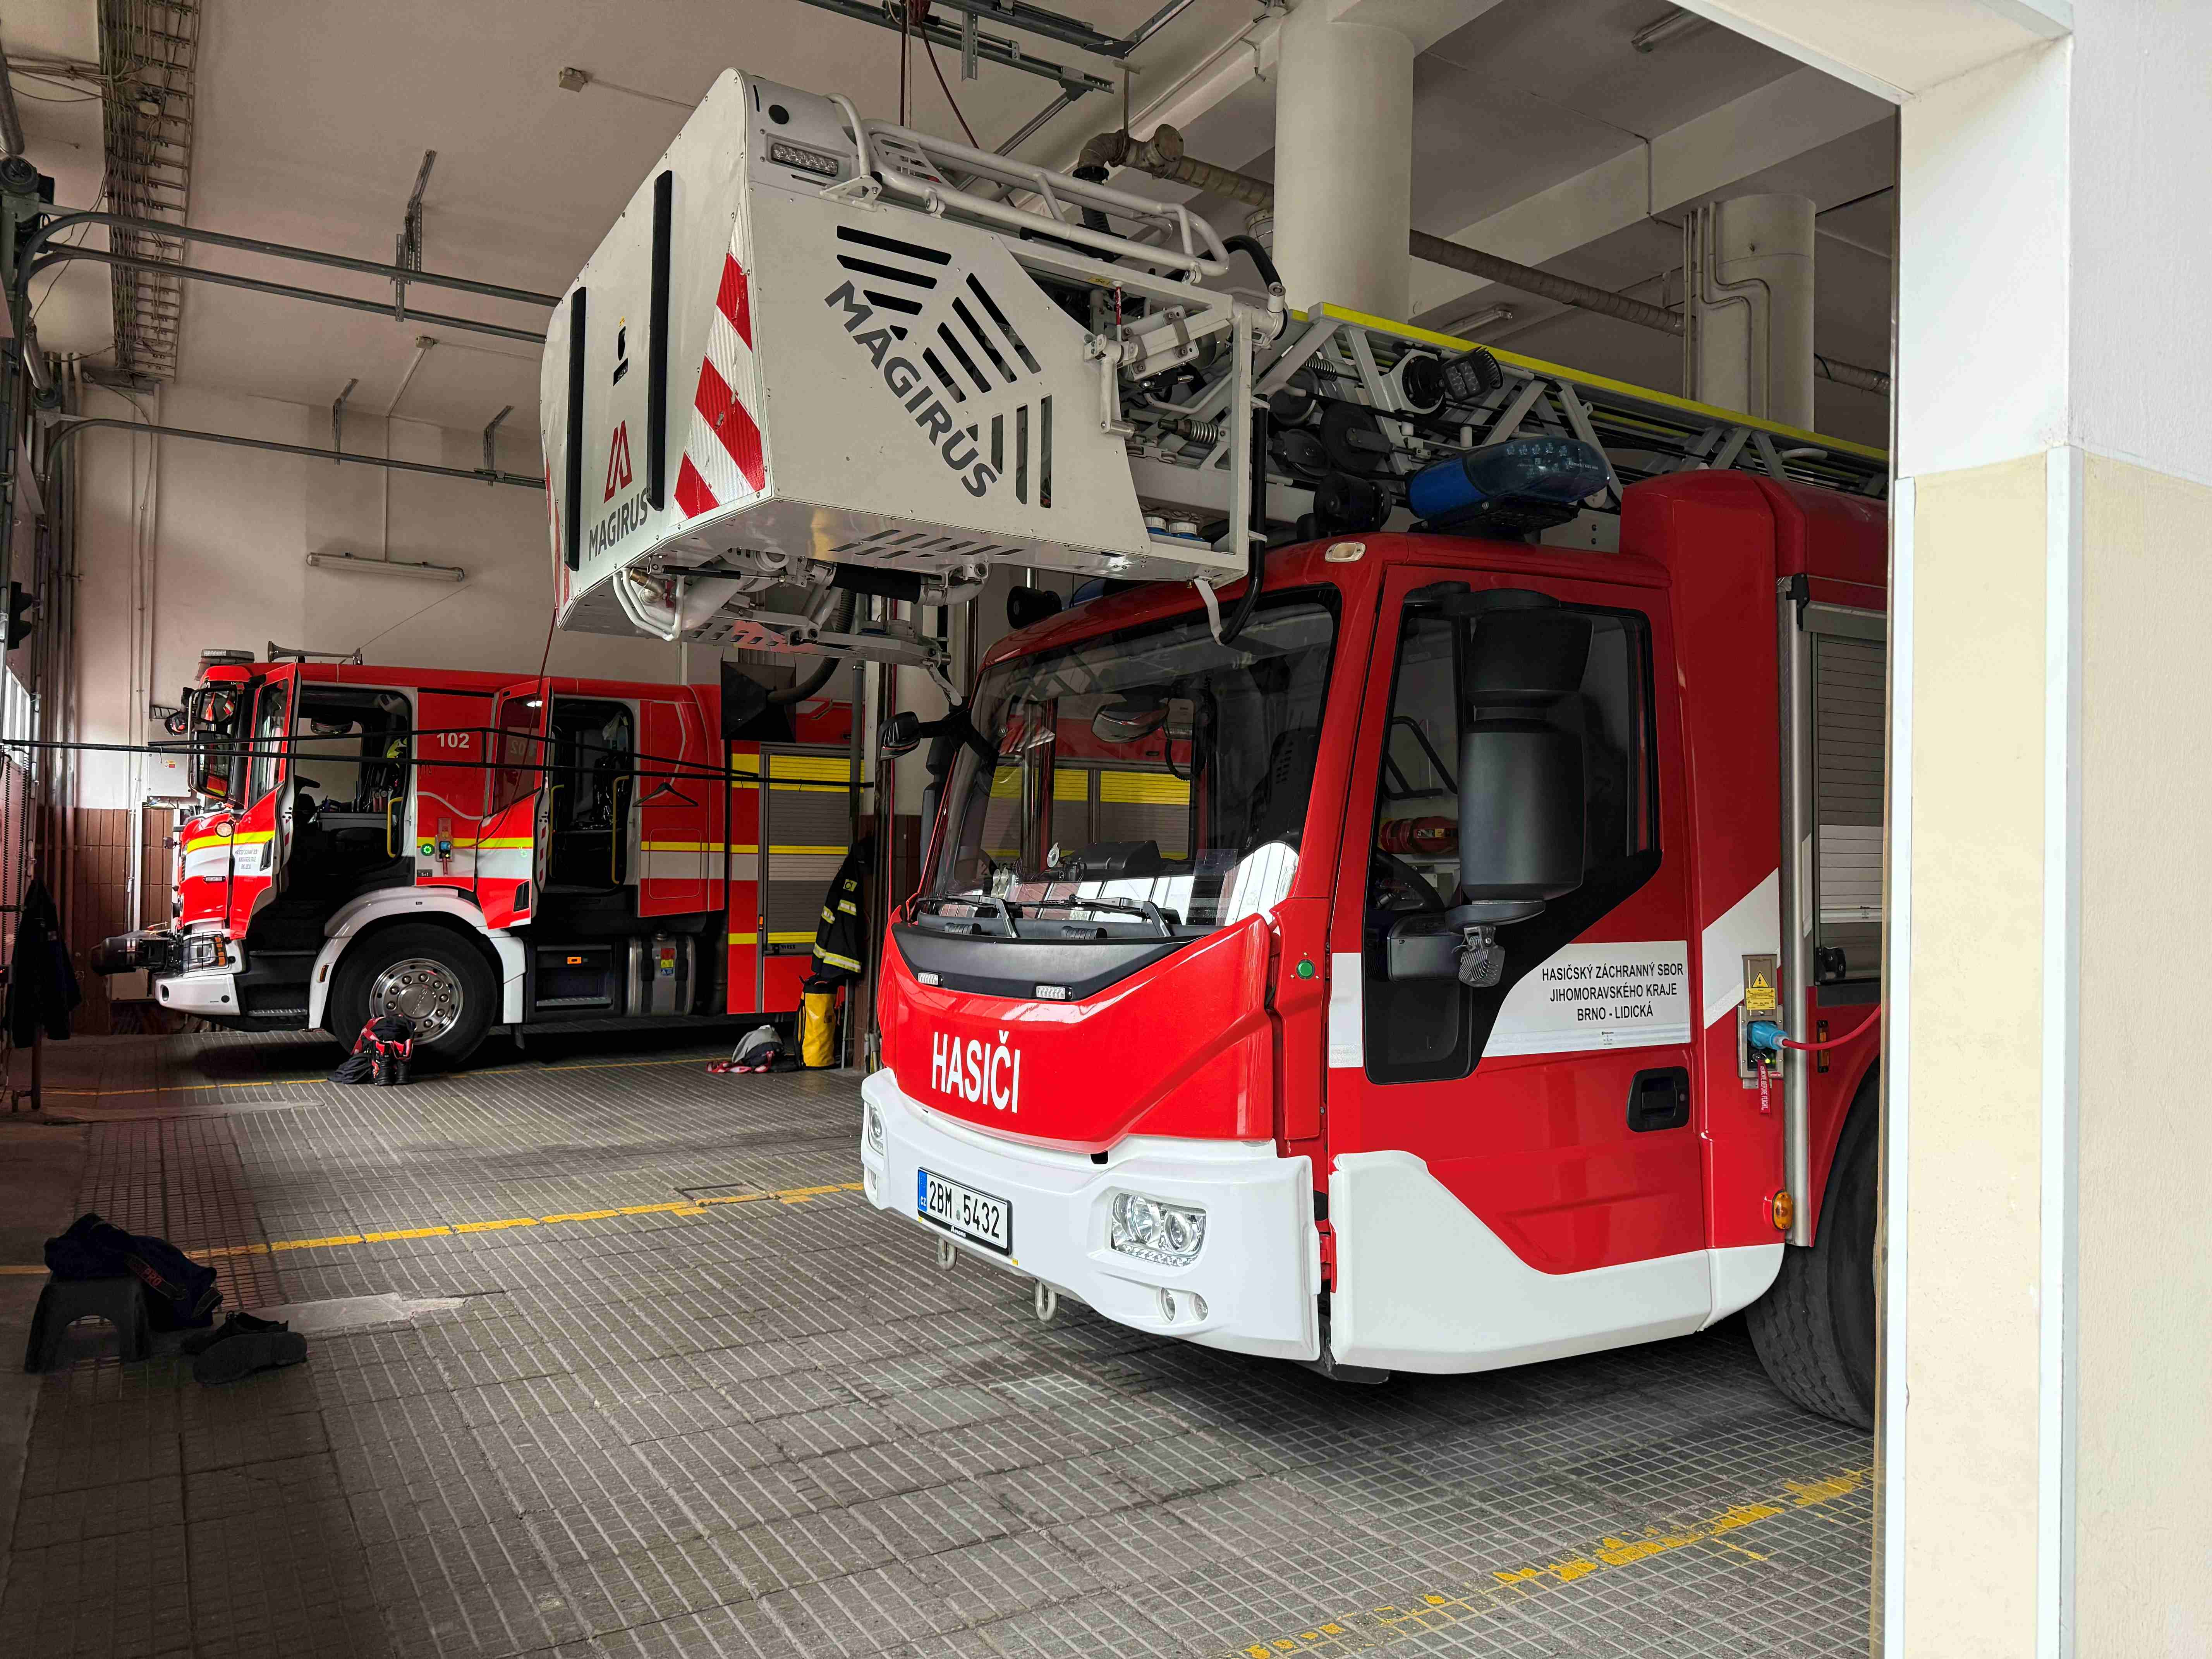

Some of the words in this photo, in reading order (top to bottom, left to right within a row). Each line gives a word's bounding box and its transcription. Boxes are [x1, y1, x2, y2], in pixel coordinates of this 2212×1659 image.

[824, 280, 998, 498] MAGIRUS
[589, 487, 648, 562] MAGIRUS
[437, 732, 469, 748] 102
[1542, 964, 1593, 981] HASIČSKÝ
[1596, 962, 1655, 979] ZÁCHRANNÝ
[1657, 963, 1683, 976] SBOR
[1550, 982, 1643, 1001] JIHOMORAVSKÉHO
[1646, 983, 1677, 996] KRAJE
[1577, 1007, 1606, 1021] BRNO
[1615, 1001, 1653, 1018] LIDICKÁ
[932, 1029, 1020, 1114] HASIČI
[920, 1196, 926, 1206] CZ
[929, 1181, 952, 1219] 2BM
[963, 1194, 999, 1239] 5432
